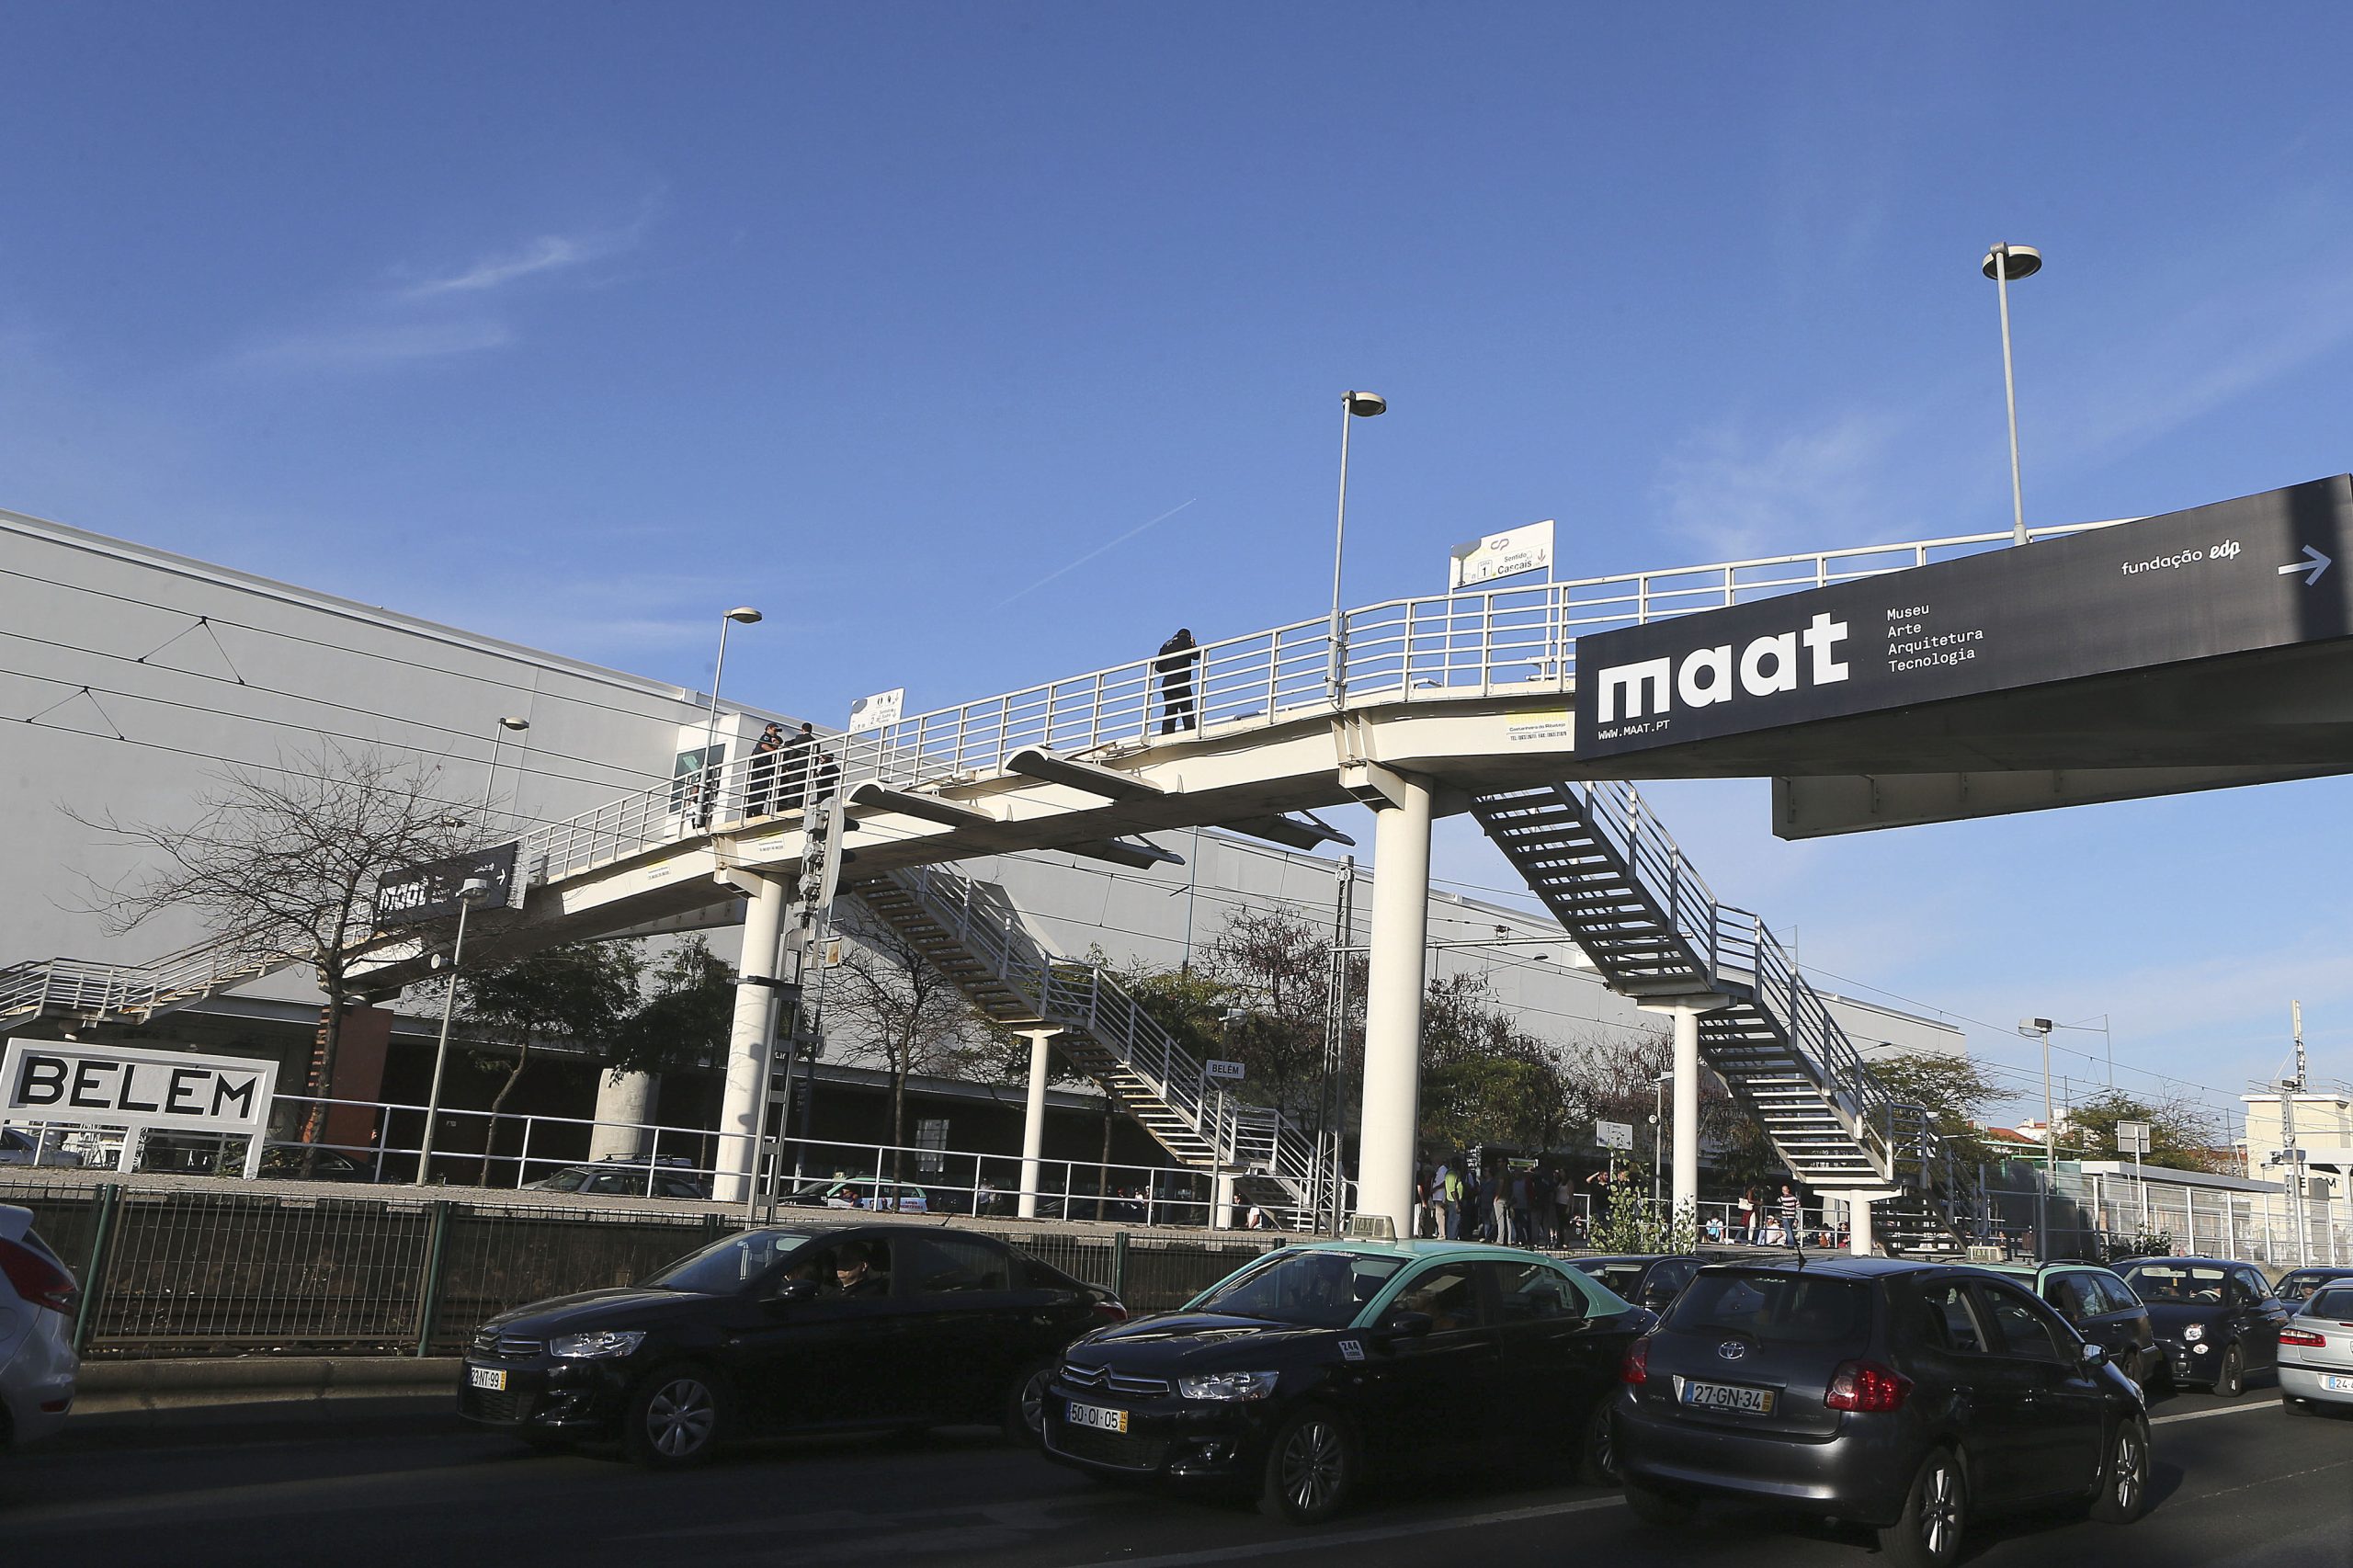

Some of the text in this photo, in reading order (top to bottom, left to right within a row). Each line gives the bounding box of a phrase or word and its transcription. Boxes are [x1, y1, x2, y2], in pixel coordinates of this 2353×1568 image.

[1504, 552, 1528, 563] Sentido
[2121, 539, 2242, 575] fundação edp
[1482, 566, 1487, 577] 1
[1497, 559, 1532, 574] Cascais
[1887, 604, 1929, 621] Museu
[1887, 622, 1922, 639] Arte
[1888, 629, 1984, 655] Arquitetura
[1597, 611, 1849, 724] maat
[1888, 647, 1976, 673] Tecnologia
[1597, 719, 1671, 741] WWW.MAAT.PT
[1211, 1062, 1239, 1074] BELÉM
[1356, 1218, 1374, 1231] TAXI
[1341, 1341, 1359, 1351] 244
